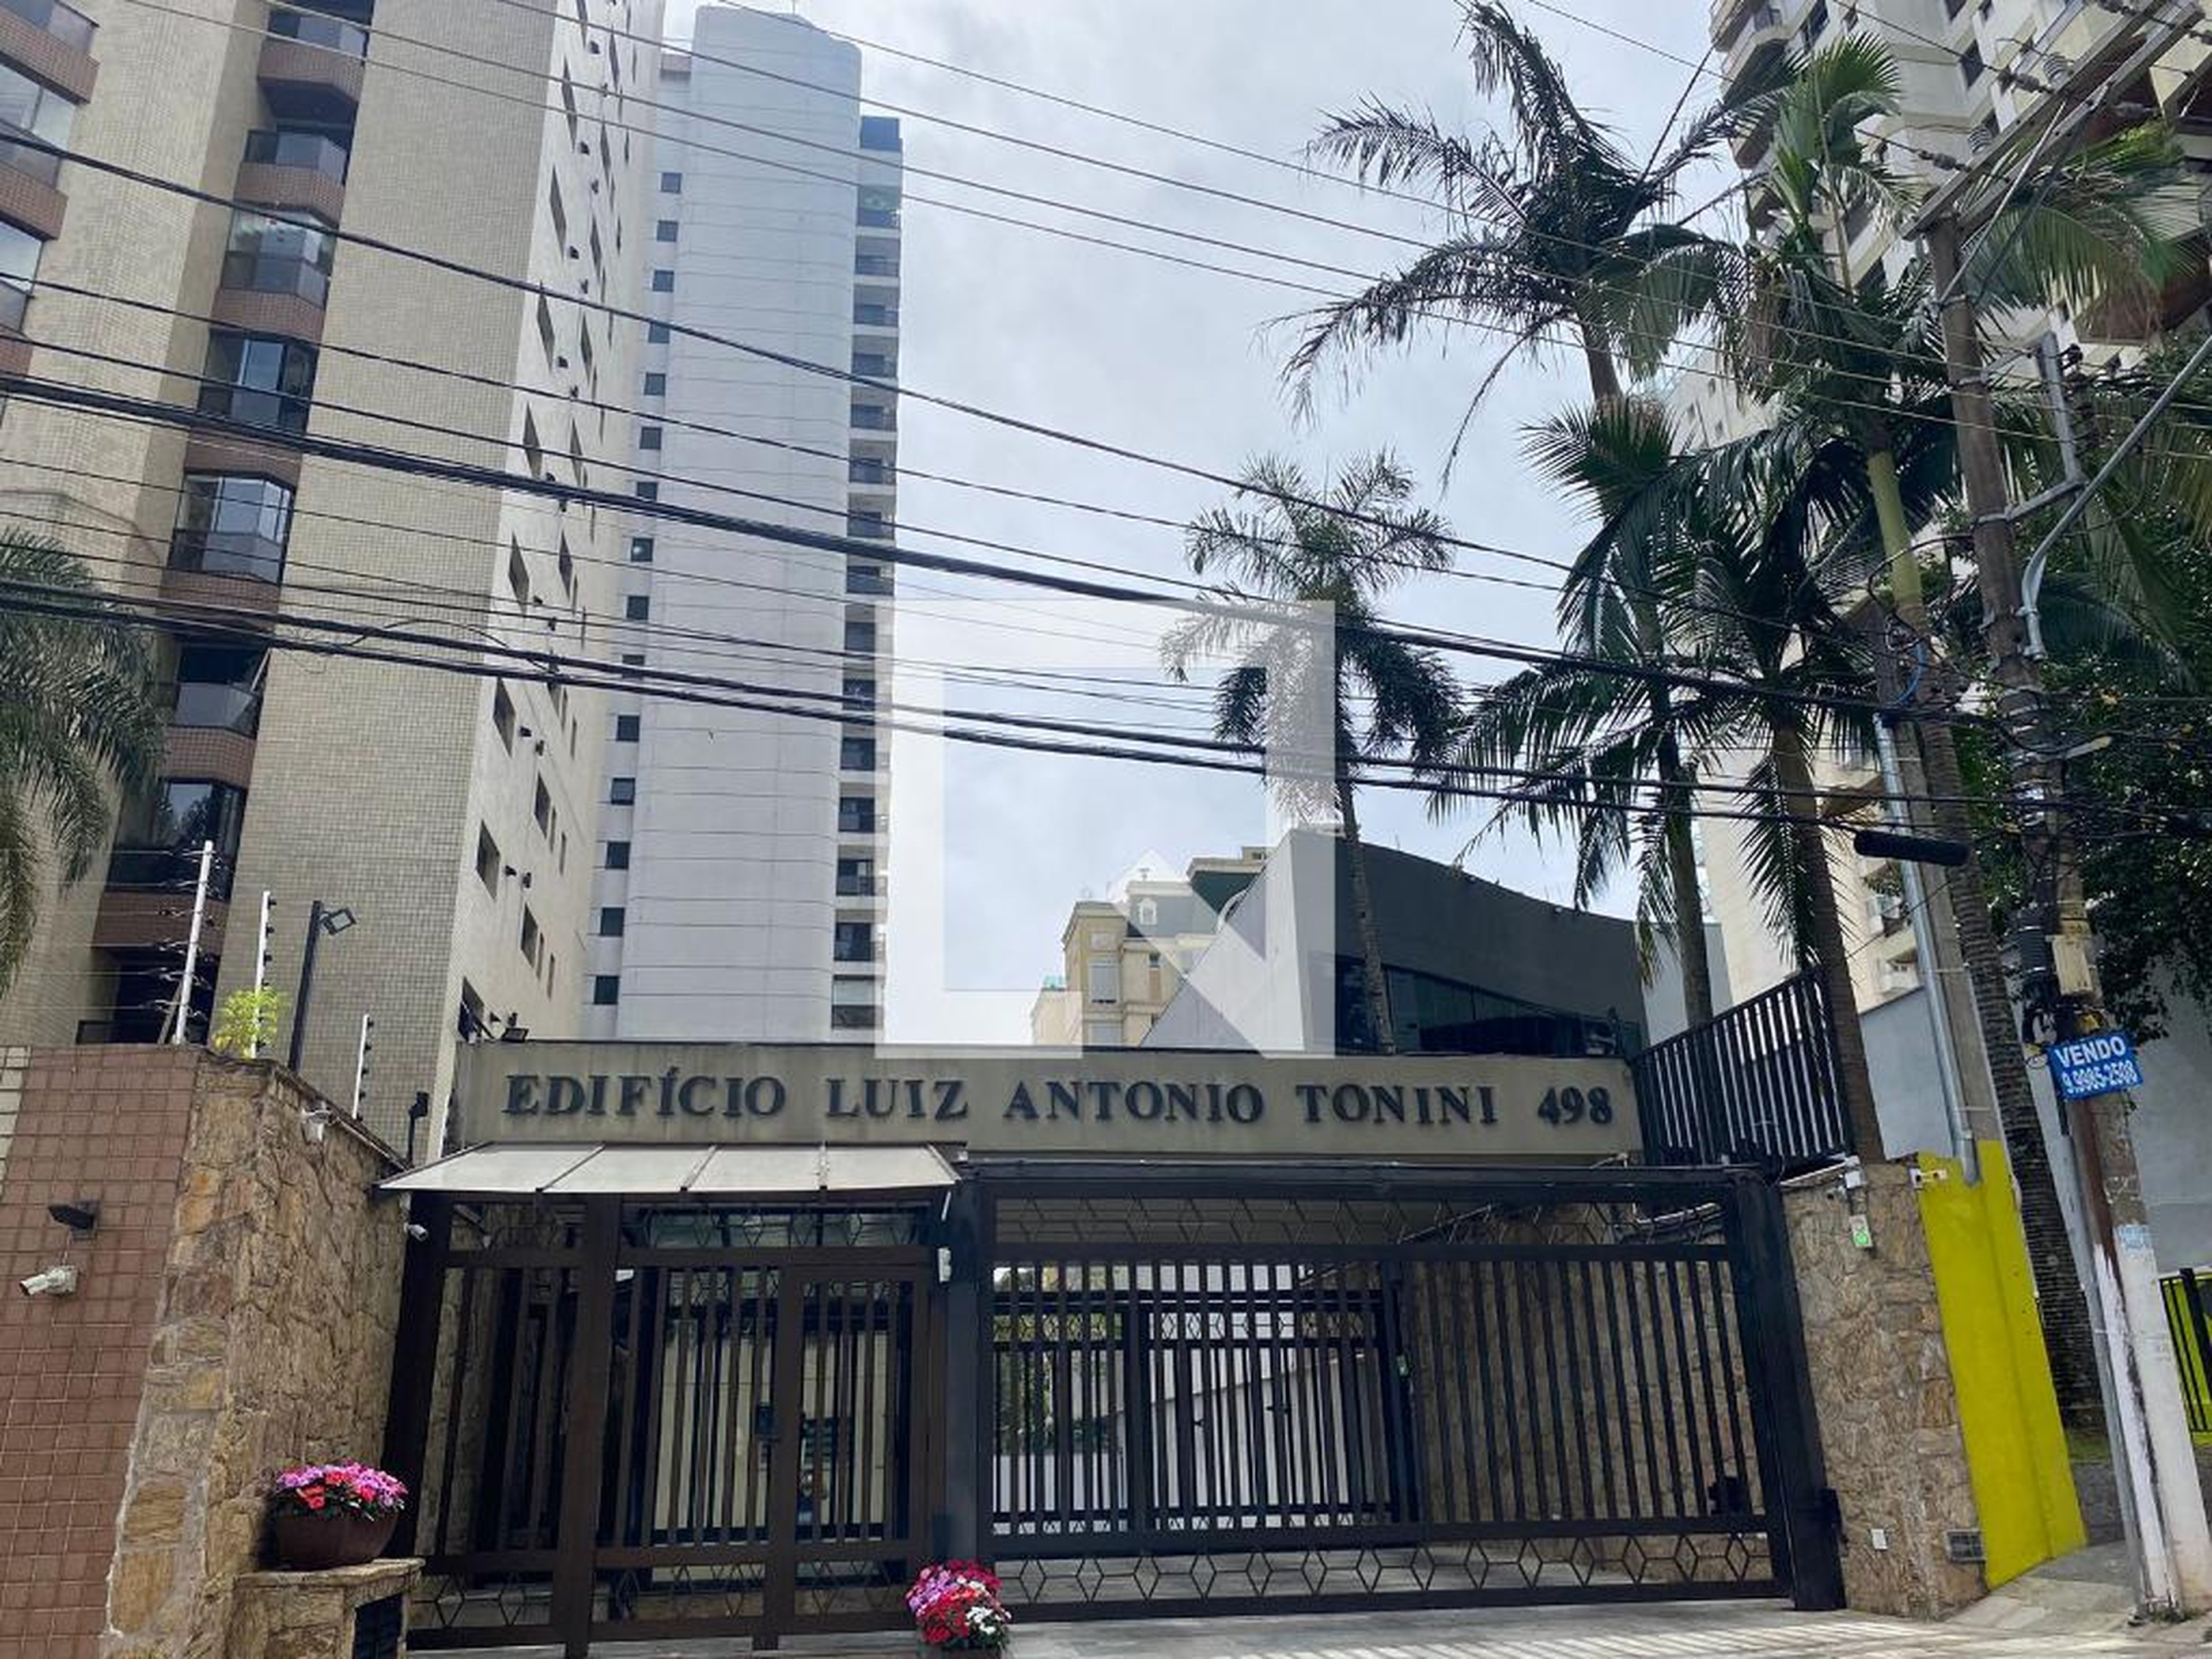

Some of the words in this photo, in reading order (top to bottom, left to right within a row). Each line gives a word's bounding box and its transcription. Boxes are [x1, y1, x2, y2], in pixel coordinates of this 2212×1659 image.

[2054, 1036, 2126, 1067] VENDO
[502, 1067, 786, 1118] EDIFÍCIO
[825, 1078, 969, 1119] LUIZ
[1003, 1081, 1264, 1124] ANTONIO
[1295, 1085, 1498, 1124] TONINI
[1536, 1086, 1612, 1124] 498
